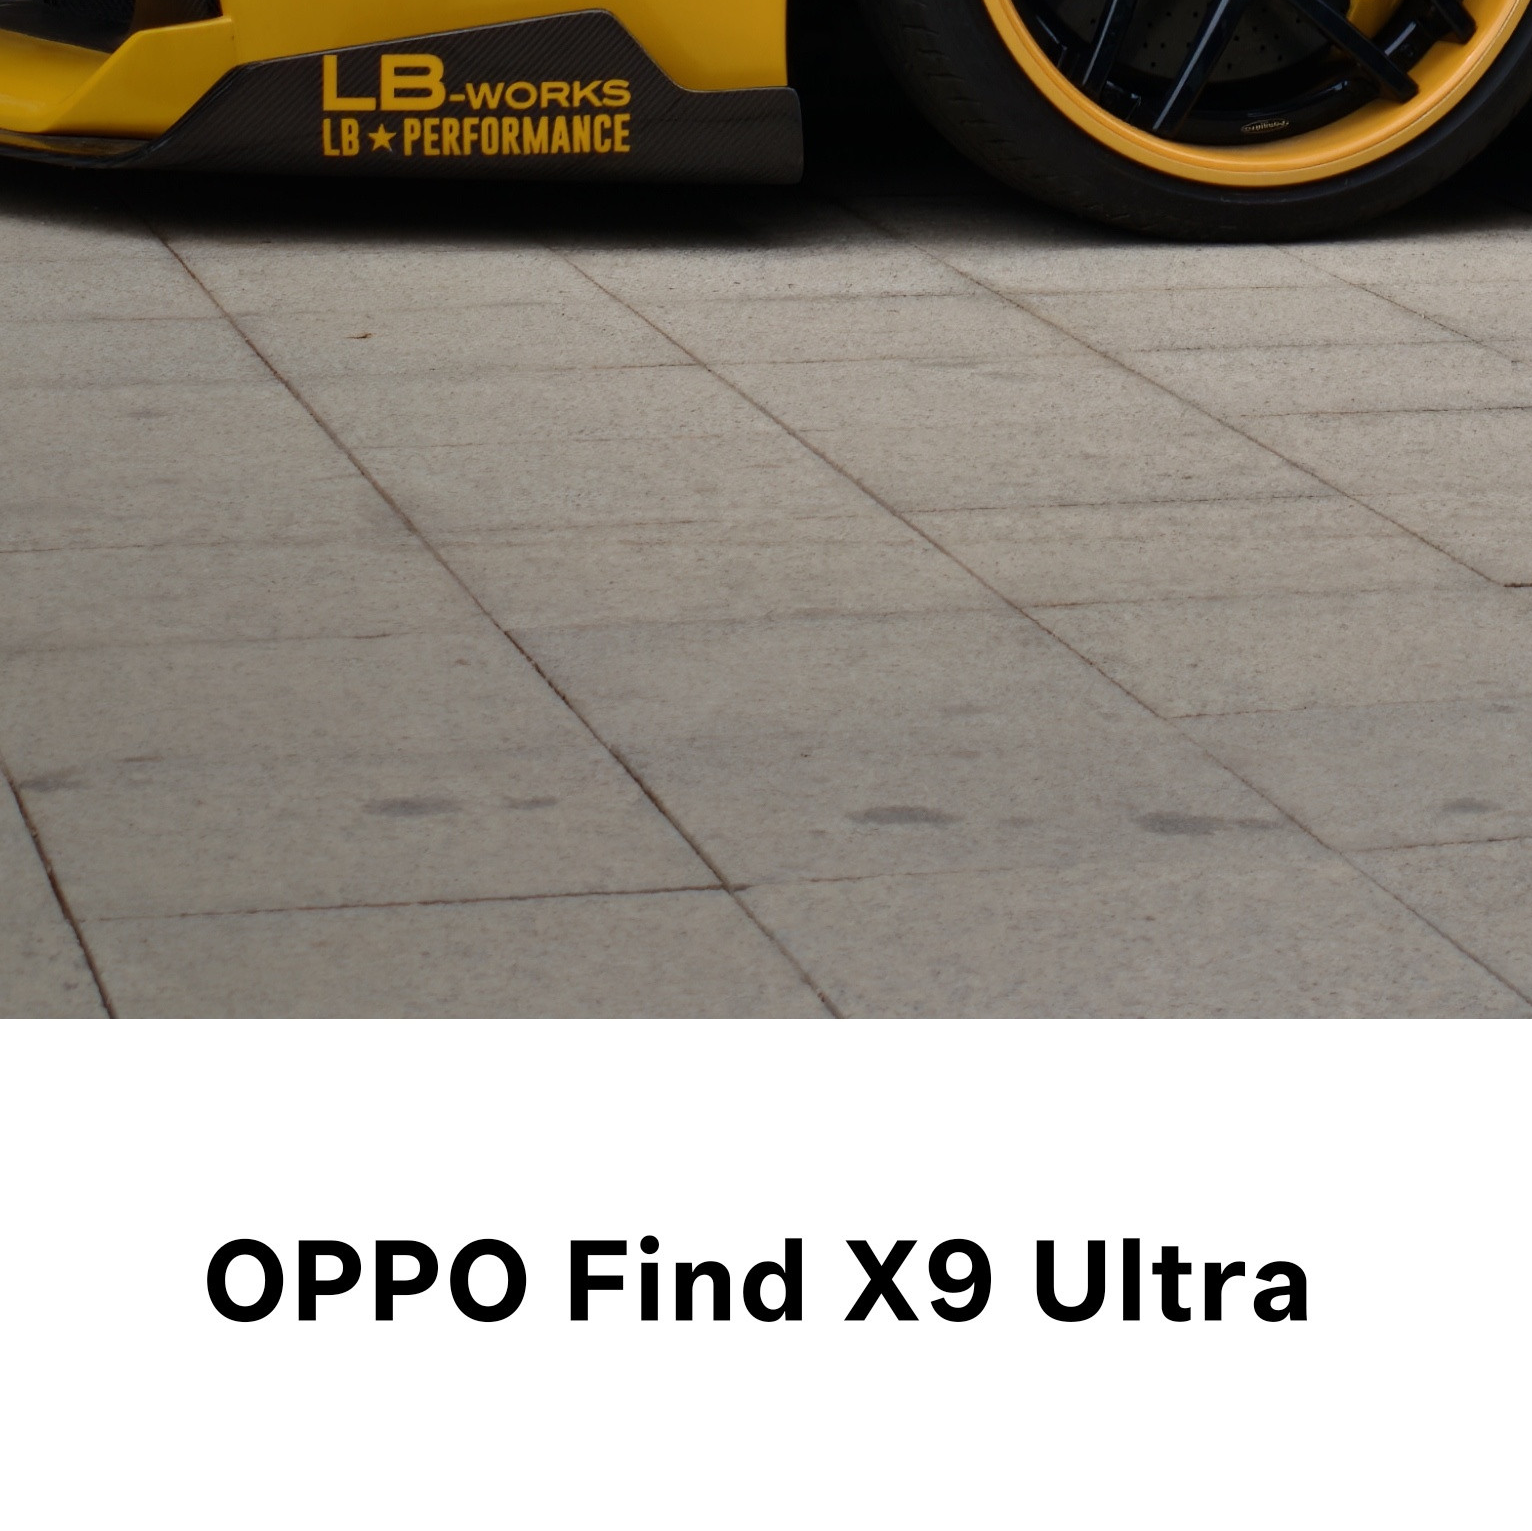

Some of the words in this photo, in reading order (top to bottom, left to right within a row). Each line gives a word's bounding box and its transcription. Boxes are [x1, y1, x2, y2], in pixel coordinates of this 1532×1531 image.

[322, 52, 632, 112] LB-WORKS
[322, 117, 361, 157] LB
[403, 113, 631, 157] PERFORMANCE
